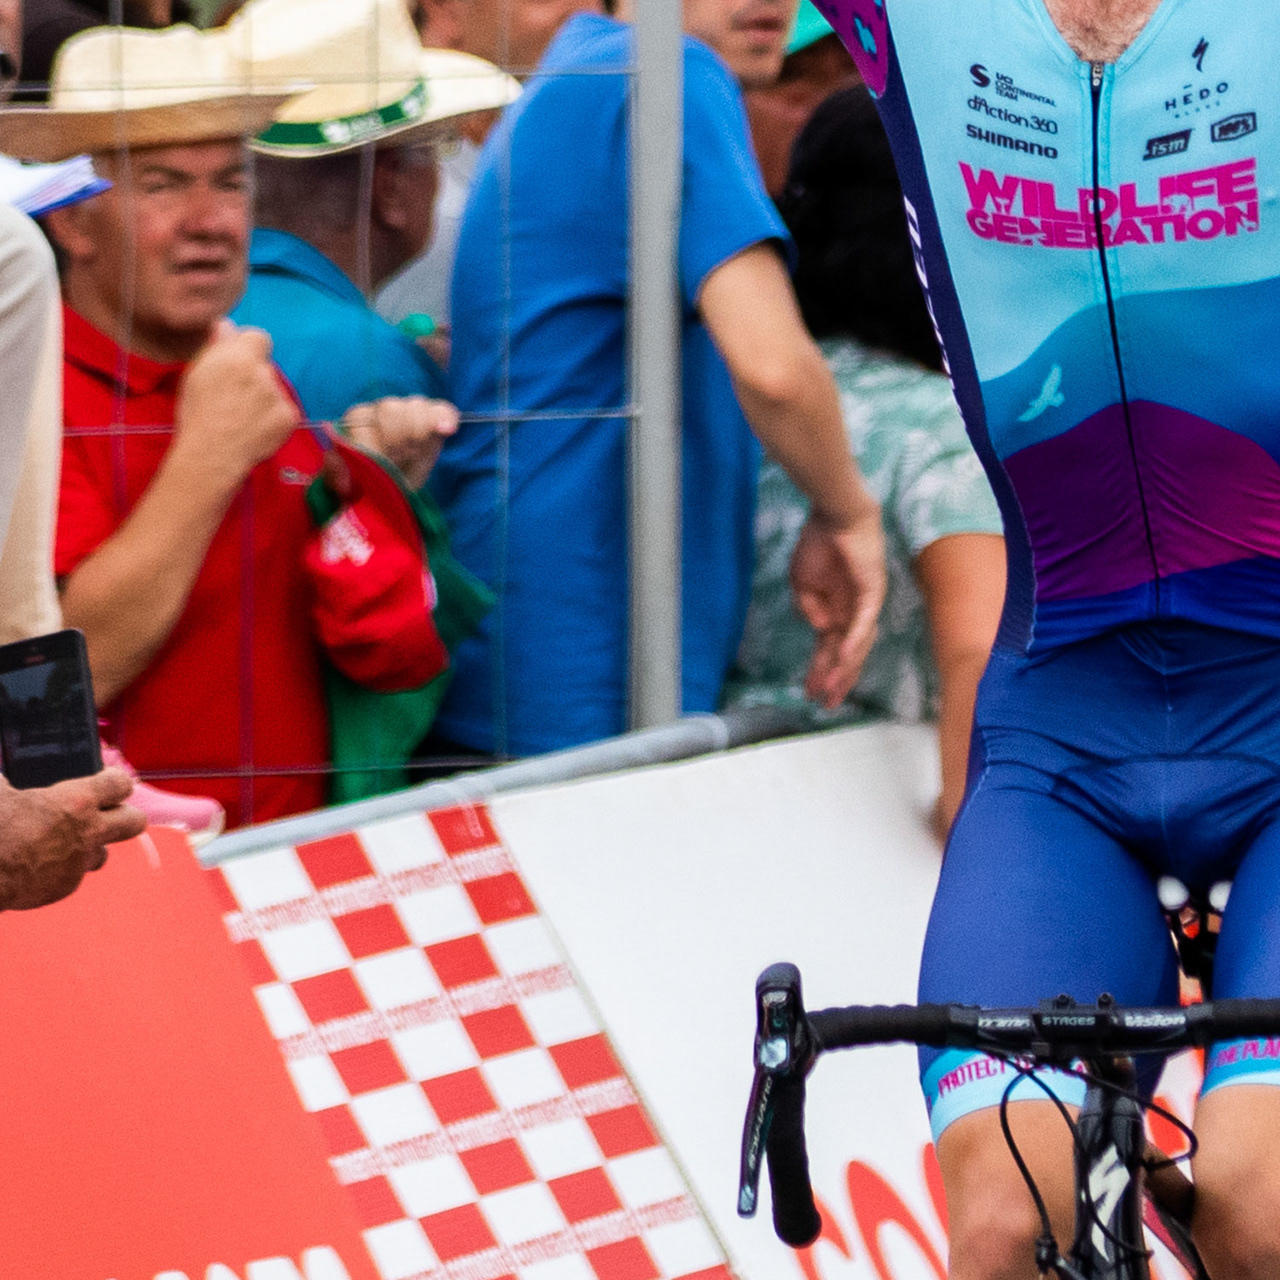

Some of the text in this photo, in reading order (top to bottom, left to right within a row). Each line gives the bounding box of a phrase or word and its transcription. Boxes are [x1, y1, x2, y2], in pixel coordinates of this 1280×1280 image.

[966, 123, 1059, 160] SHIMANO
[1150, 138, 1187, 156] ism
[957, 156, 1259, 222] WILDLIFE
[965, 200, 1260, 250] GENERATION
[1041, 1015, 1097, 1027] STAGES
